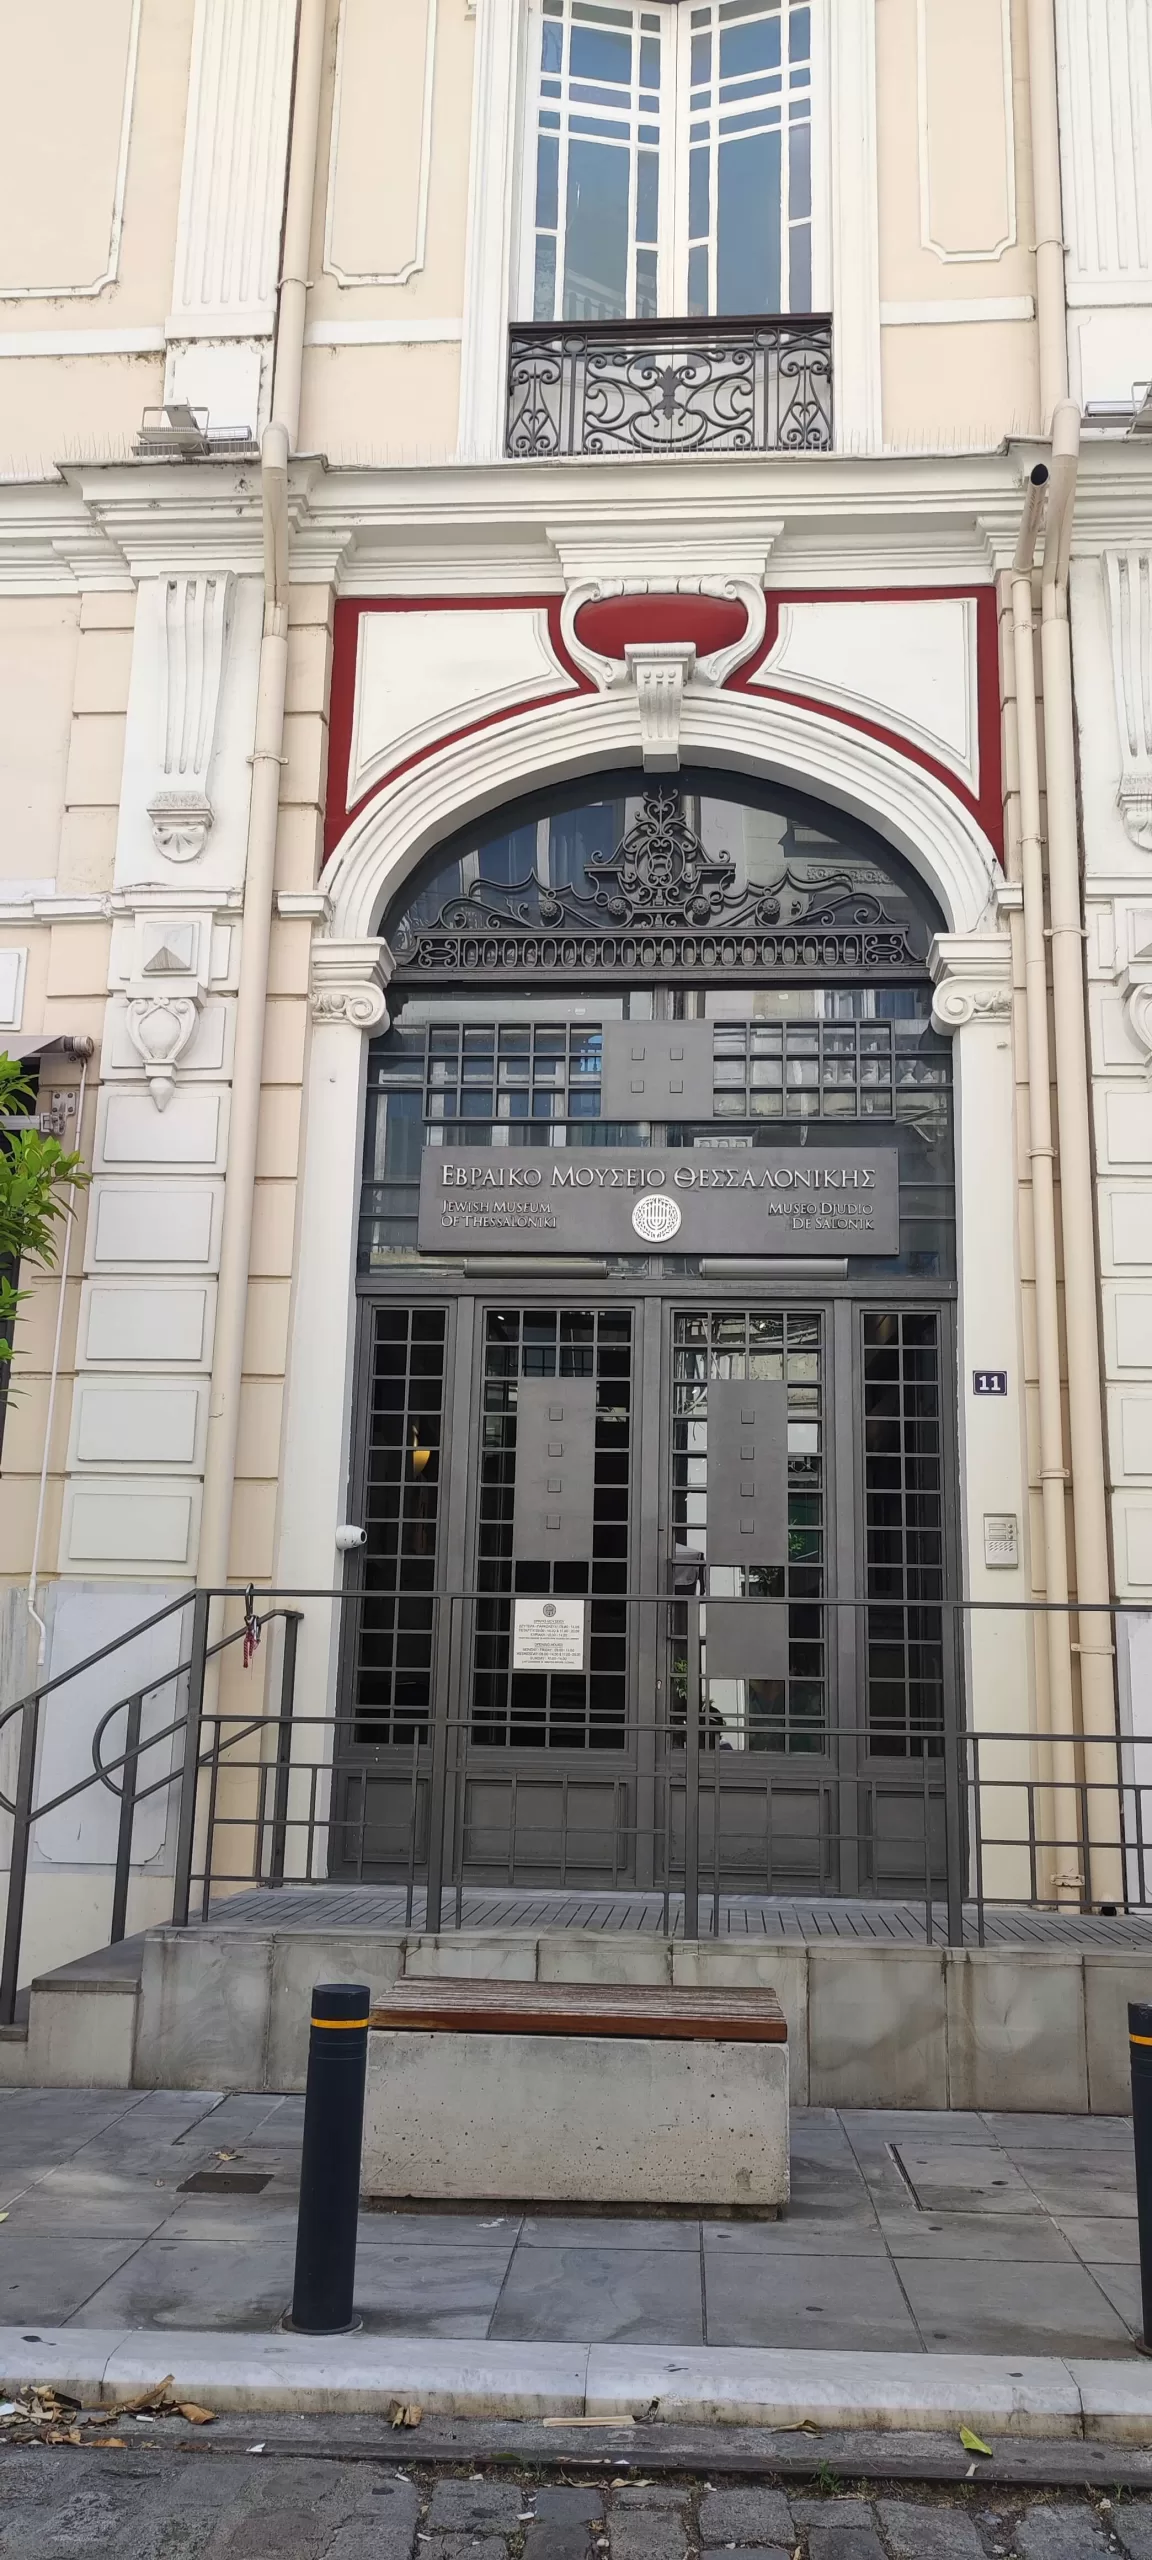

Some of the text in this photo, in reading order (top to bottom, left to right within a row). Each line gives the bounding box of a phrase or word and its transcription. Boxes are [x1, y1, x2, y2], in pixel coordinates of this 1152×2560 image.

[441, 1164, 876, 1189] ΕΒΡΑΙΚΟ ΜΟΥΣΕΙΟ ΘΕΣΣΑΛΟΝΙΚΗΣ
[441, 1200, 552, 1214] JEWISH MUSEUM
[768, 1202, 873, 1216] MUSEO DJUDIO
[441, 1214, 557, 1228] OF THESSALONIKI
[792, 1217, 874, 1230] DE SALONIK
[979, 1375, 1001, 1391] 11
